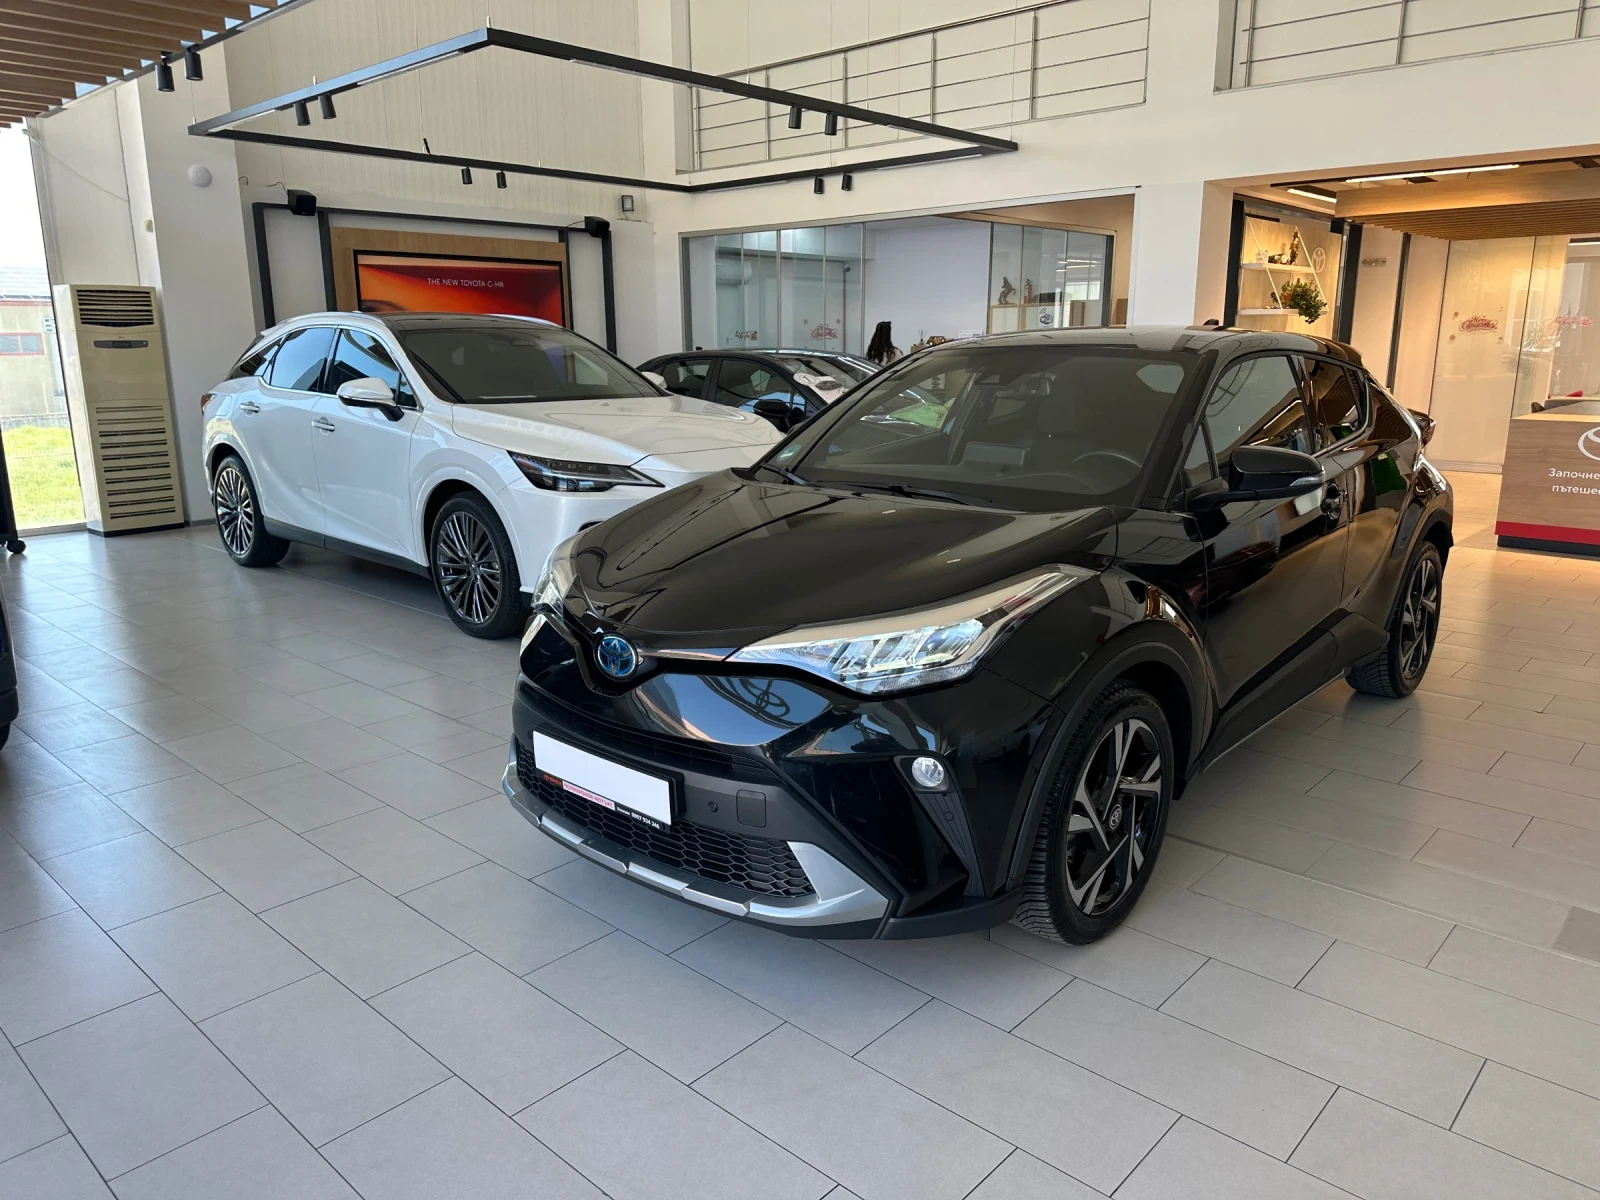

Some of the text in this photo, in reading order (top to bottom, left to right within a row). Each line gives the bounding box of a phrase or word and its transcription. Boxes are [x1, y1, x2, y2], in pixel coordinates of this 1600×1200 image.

[427, 277, 505, 288] THE NEW TOYOTA C-HR
[1548, 467, 1600, 480] Започне
